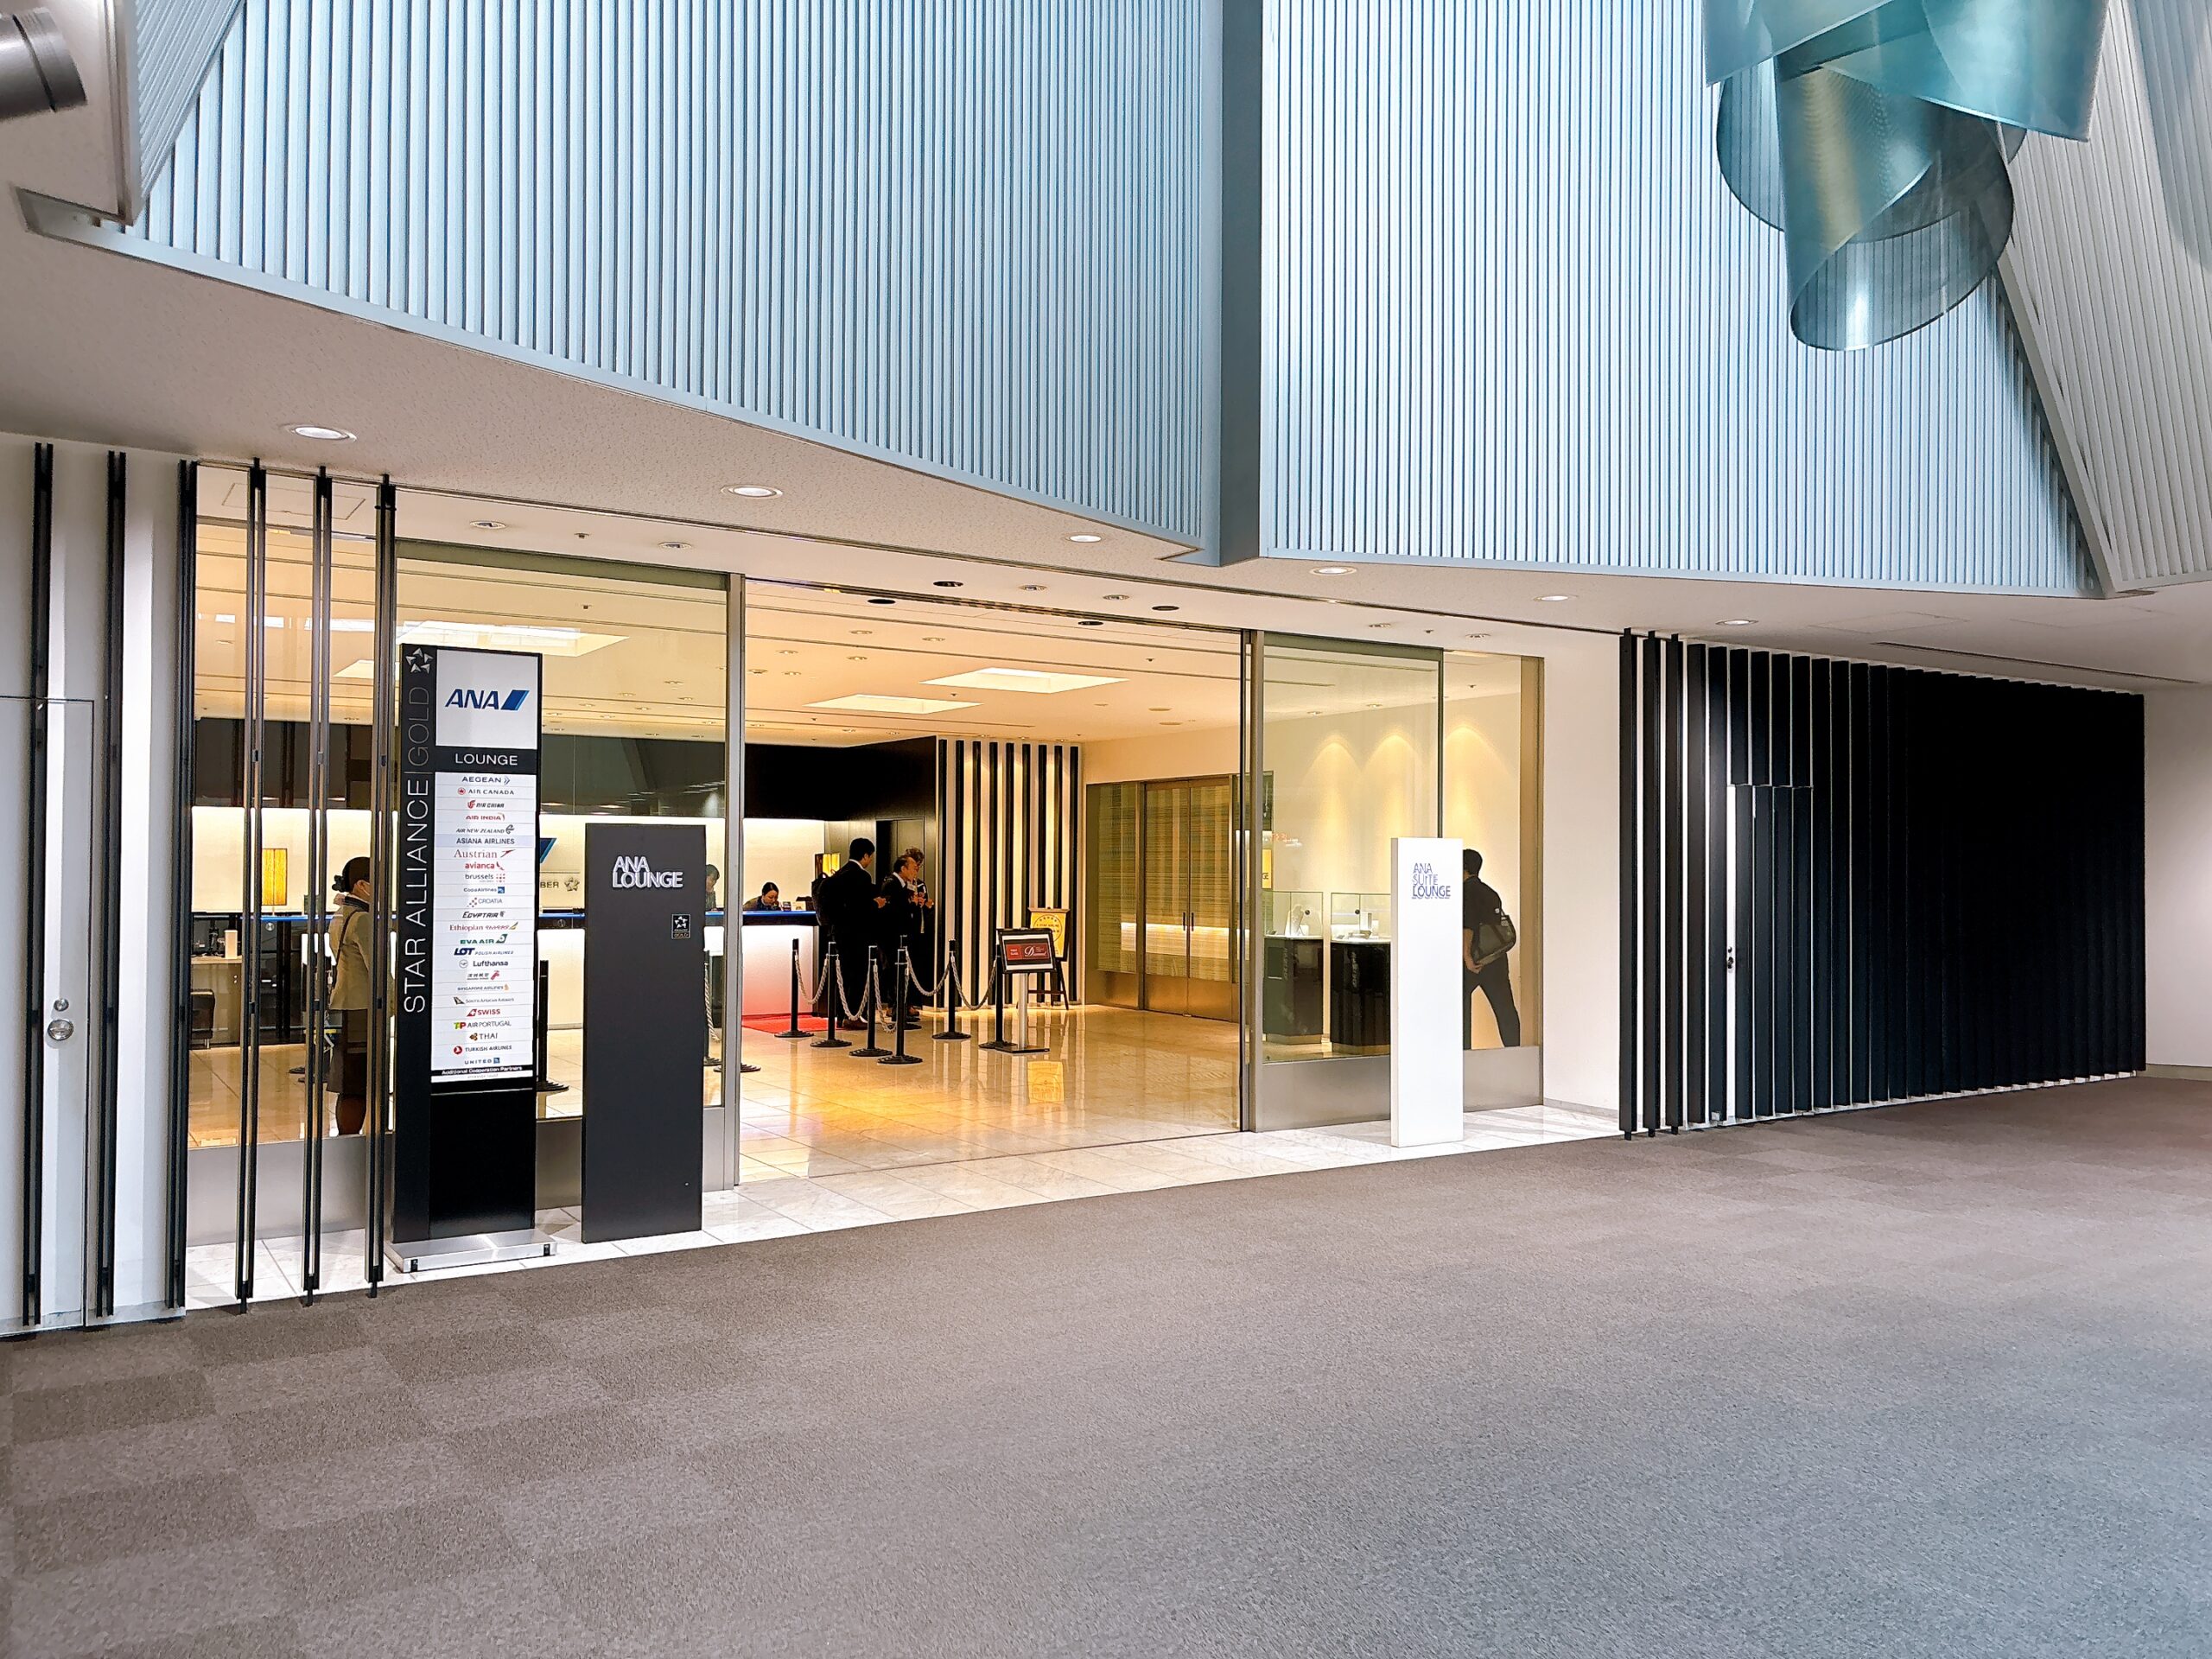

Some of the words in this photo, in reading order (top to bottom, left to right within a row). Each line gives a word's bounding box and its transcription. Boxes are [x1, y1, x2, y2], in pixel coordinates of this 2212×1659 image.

[445, 689, 499, 709] ANA
[408, 687, 429, 766] GOLD
[455, 753, 518, 766] LOUNGE
[406, 779, 429, 927] ALLIANCE
[454, 849, 498, 858] Austrian
[613, 855, 649, 873] ANA
[1413, 863, 1433, 874] ANA
[612, 871, 683, 888] LOUNGE
[1413, 874, 1438, 885] SUITE
[1413, 886, 1451, 897] LOUNGE
[404, 938, 426, 1013] STAR
